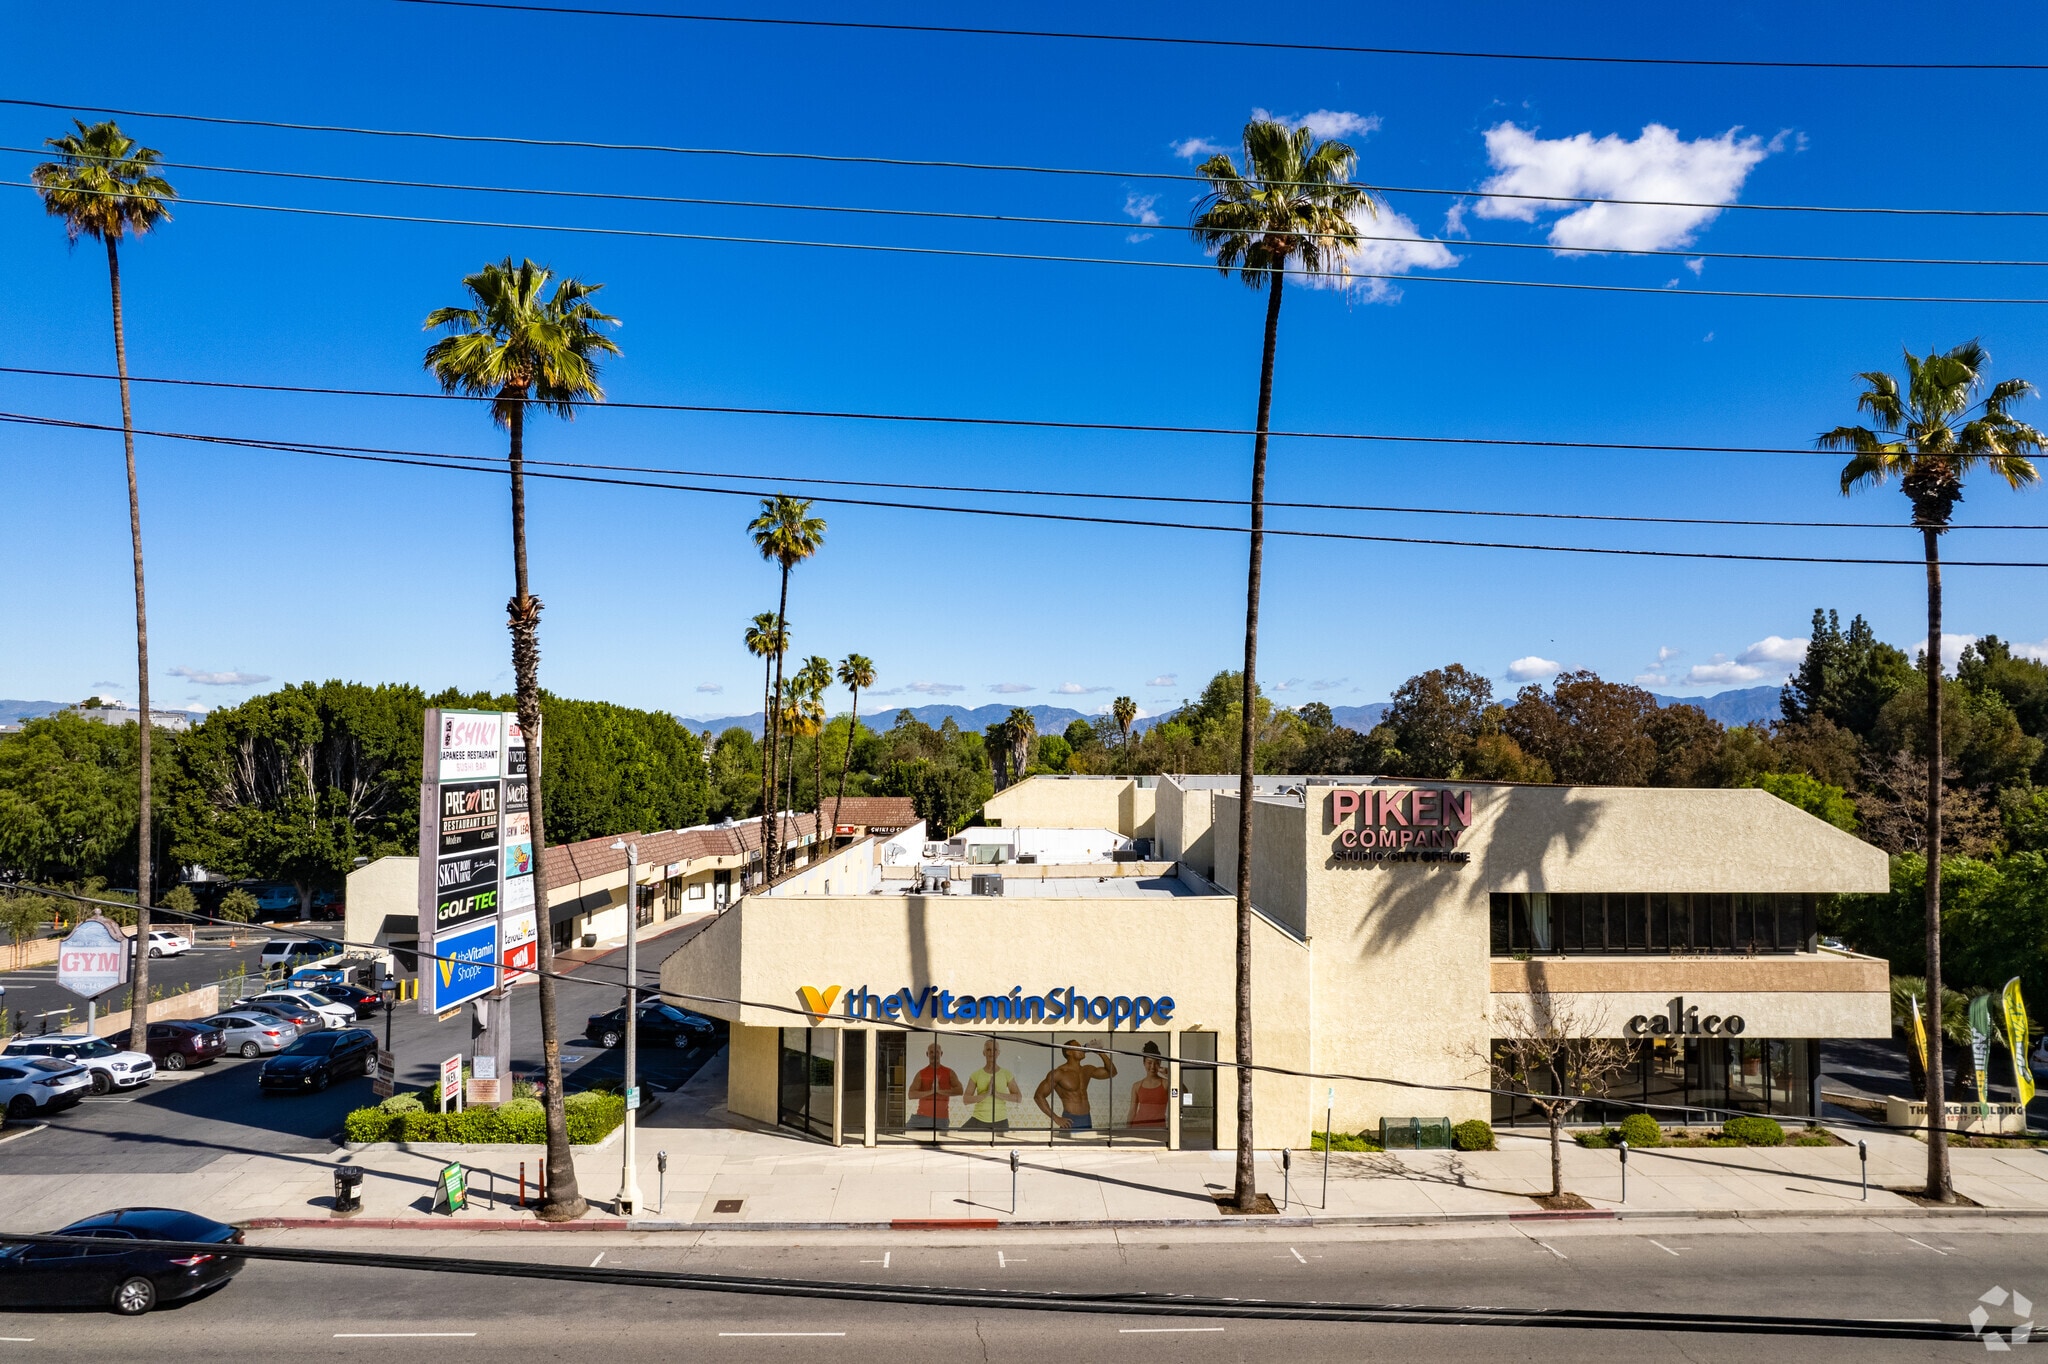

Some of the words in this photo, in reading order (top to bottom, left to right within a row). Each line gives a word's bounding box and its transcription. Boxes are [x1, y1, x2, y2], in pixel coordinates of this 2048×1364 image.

[454, 721, 497, 747] SHIKI
[440, 751, 466, 760] JAPANESE
[467, 750, 498, 759] RESTAURANT
[456, 763, 474, 772] SUSHI
[475, 762, 487, 771] BAR
[445, 788, 496, 816] PREMIER
[1332, 789, 1472, 827] PIKEN
[443, 817, 481, 832] RESTAURANT
[487, 815, 497, 826] BAR
[1341, 829, 1463, 849] COMPANY
[1334, 851, 1385, 863] STUDIO
[1388, 851, 1419, 863] CITY
[1421, 852, 1471, 863] OFFICE
[438, 891, 497, 920] GOLFTEC
[61, 952, 120, 973] GYM
[457, 964, 482, 982] Shoppe
[1629, 996, 1746, 1036] calico
